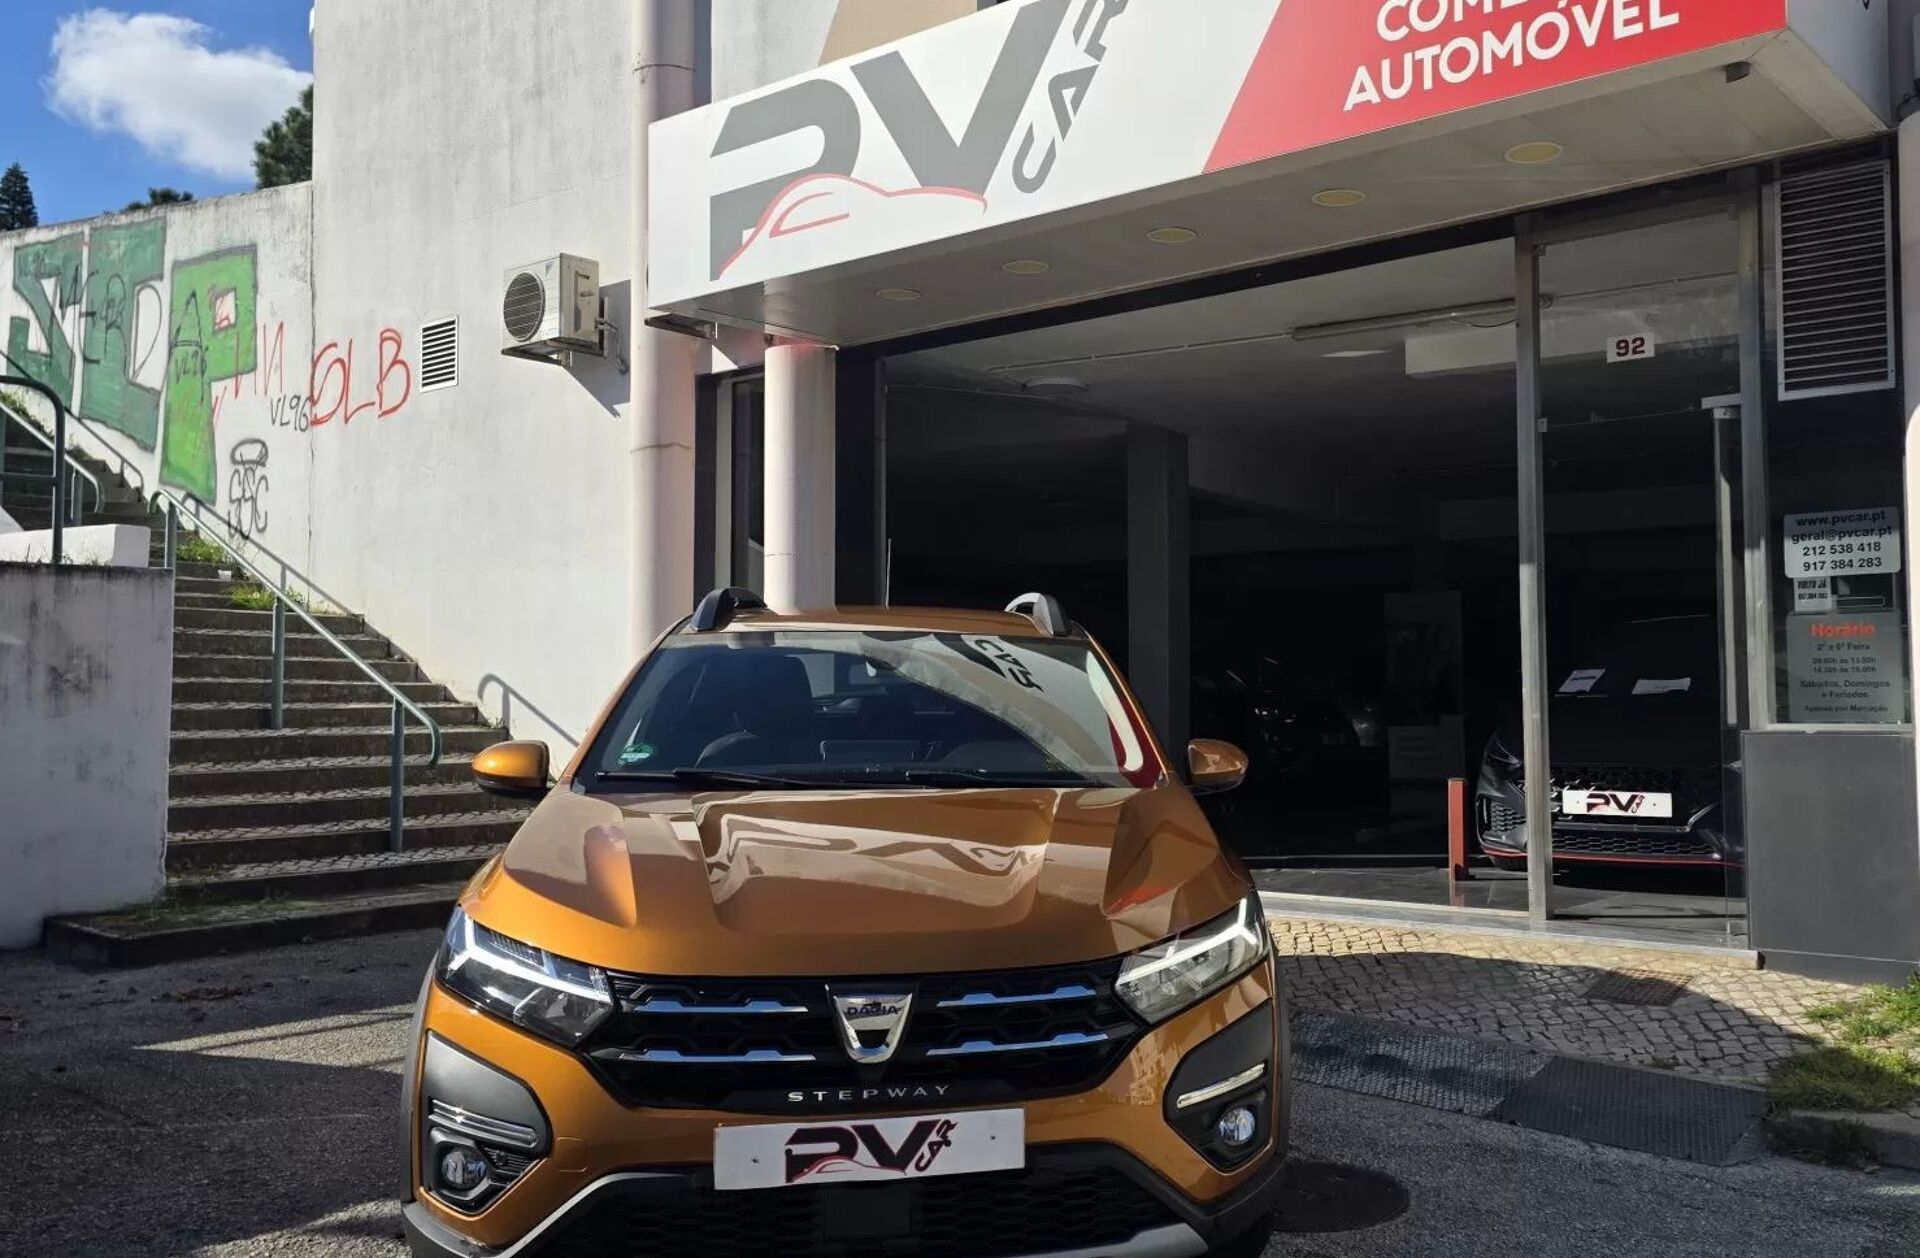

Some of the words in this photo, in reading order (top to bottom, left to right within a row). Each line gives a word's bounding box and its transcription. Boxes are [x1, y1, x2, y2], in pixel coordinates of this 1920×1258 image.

[1376, 0, 1530, 41] COM
[1342, 0, 1679, 111] AUTOMÓVEL
[710, 0, 1072, 281] PV
[1615, 337, 1646, 357] 92
[310, 327, 410, 425] SLB
[1796, 511, 1886, 526] www.pvcar.pt
[1791, 526, 1892, 544] geral@pvcar.pt
[1802, 545, 1826, 556] 212
[1829, 543, 1854, 555] 538
[1857, 541, 1881, 553] 418
[1803, 560, 1826, 572] 917
[1831, 558, 1854, 570] 384
[1858, 557, 1882, 568] 283
[1587, 793, 1639, 812] PV
[788, 1085, 949, 1102] STEPWAY
[785, 1119, 940, 1183] PV
[914, 1119, 957, 1172] CAR
